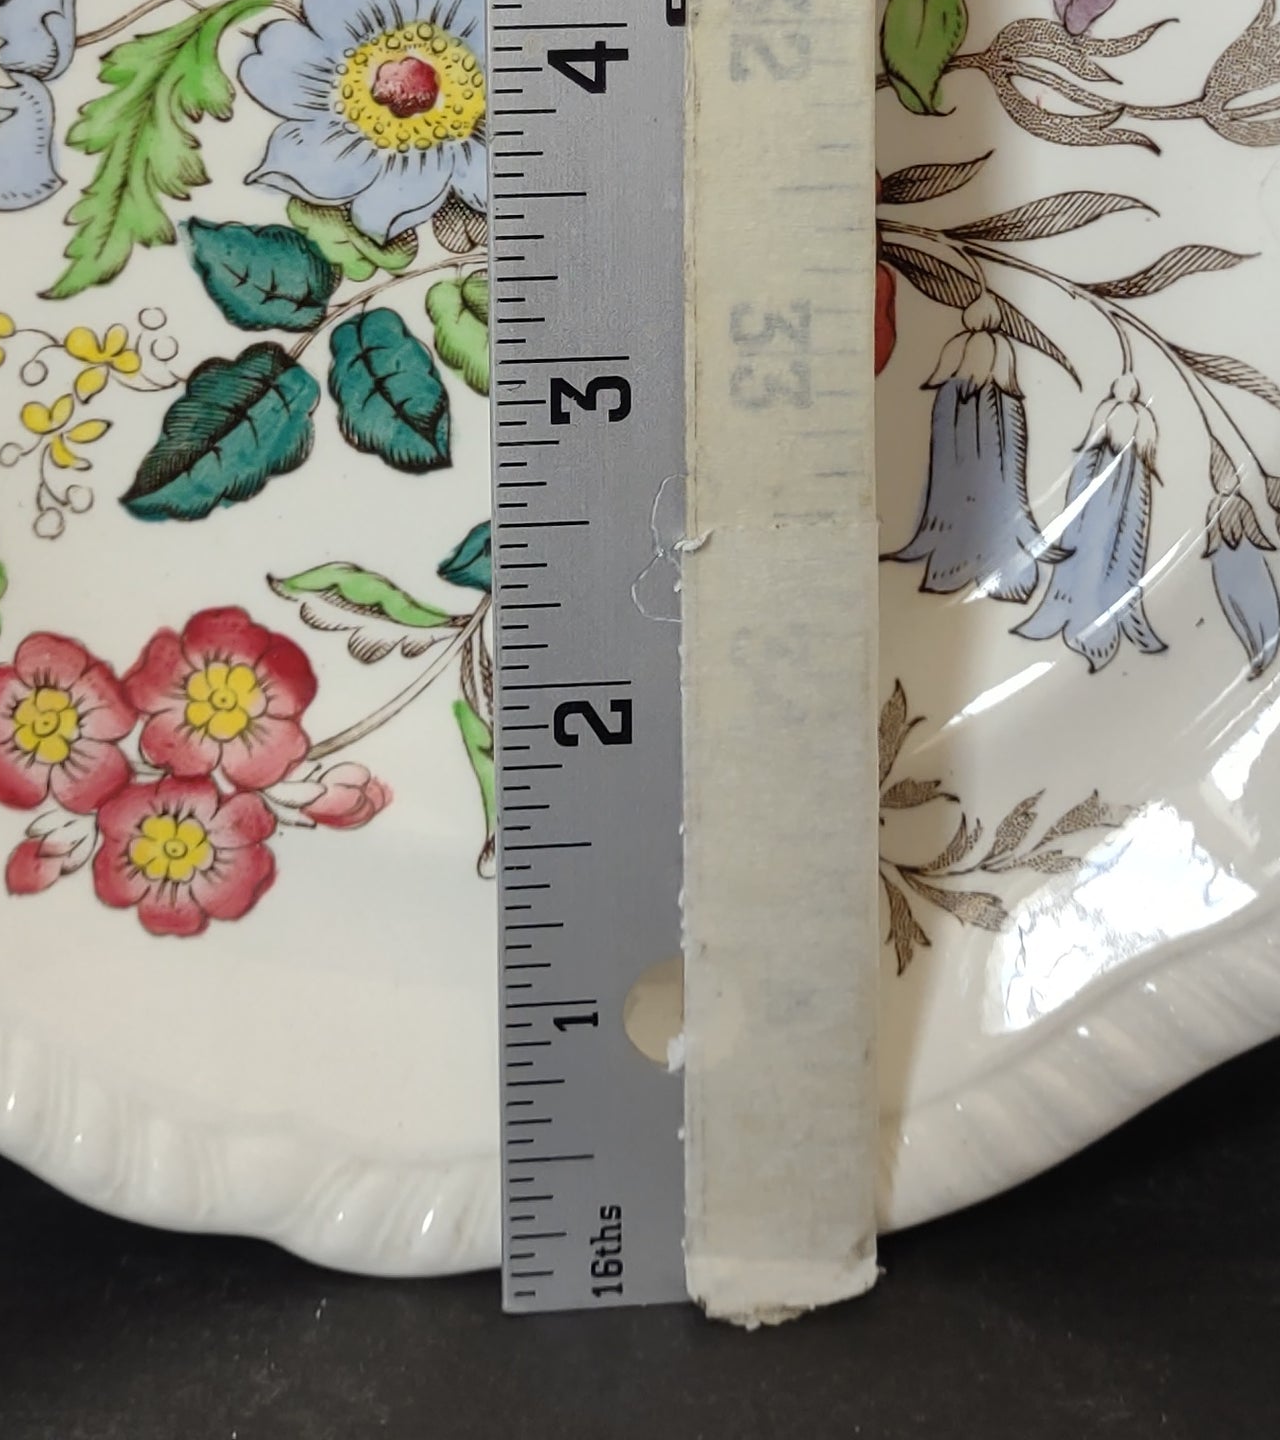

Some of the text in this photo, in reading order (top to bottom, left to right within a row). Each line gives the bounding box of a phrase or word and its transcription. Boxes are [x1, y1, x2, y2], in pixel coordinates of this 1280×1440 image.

[547, 40, 629, 94] 4
[729, 298, 812, 410] 33
[550, 375, 632, 425] 3
[553, 698, 633, 747] 2
[553, 1011, 599, 1032] 1
[590, 1204, 624, 1298] 16ths
